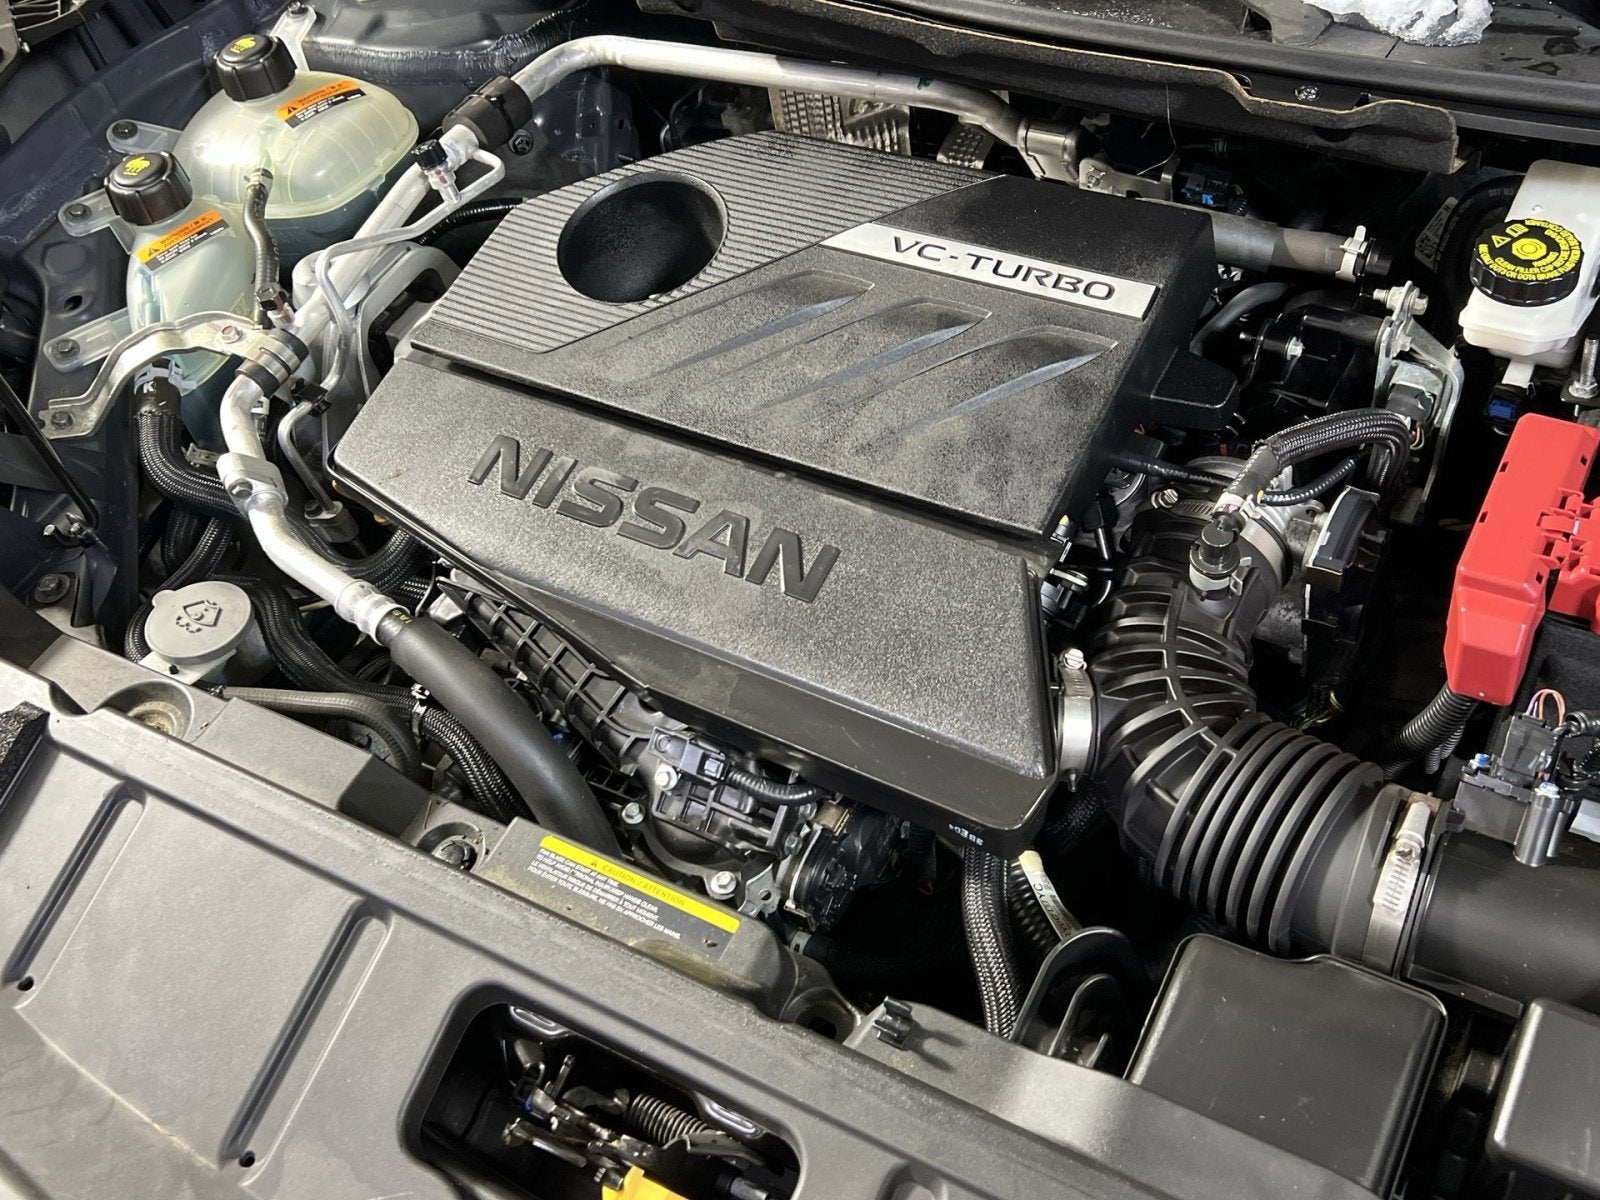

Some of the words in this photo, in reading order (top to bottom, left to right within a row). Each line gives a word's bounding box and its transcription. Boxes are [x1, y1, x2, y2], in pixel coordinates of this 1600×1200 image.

[893, 235, 1116, 301] VC-TURBO
[1495, 257, 1516, 270] CLEAN
[1515, 265, 1541, 274] FILLER
[467, 433, 840, 603] NISSAN
[527, 865, 542, 875] POUR
[564, 859, 576, 867] CAN
[601, 864, 636, 883] CAUTION
[642, 882, 685, 905] ATTENTION
